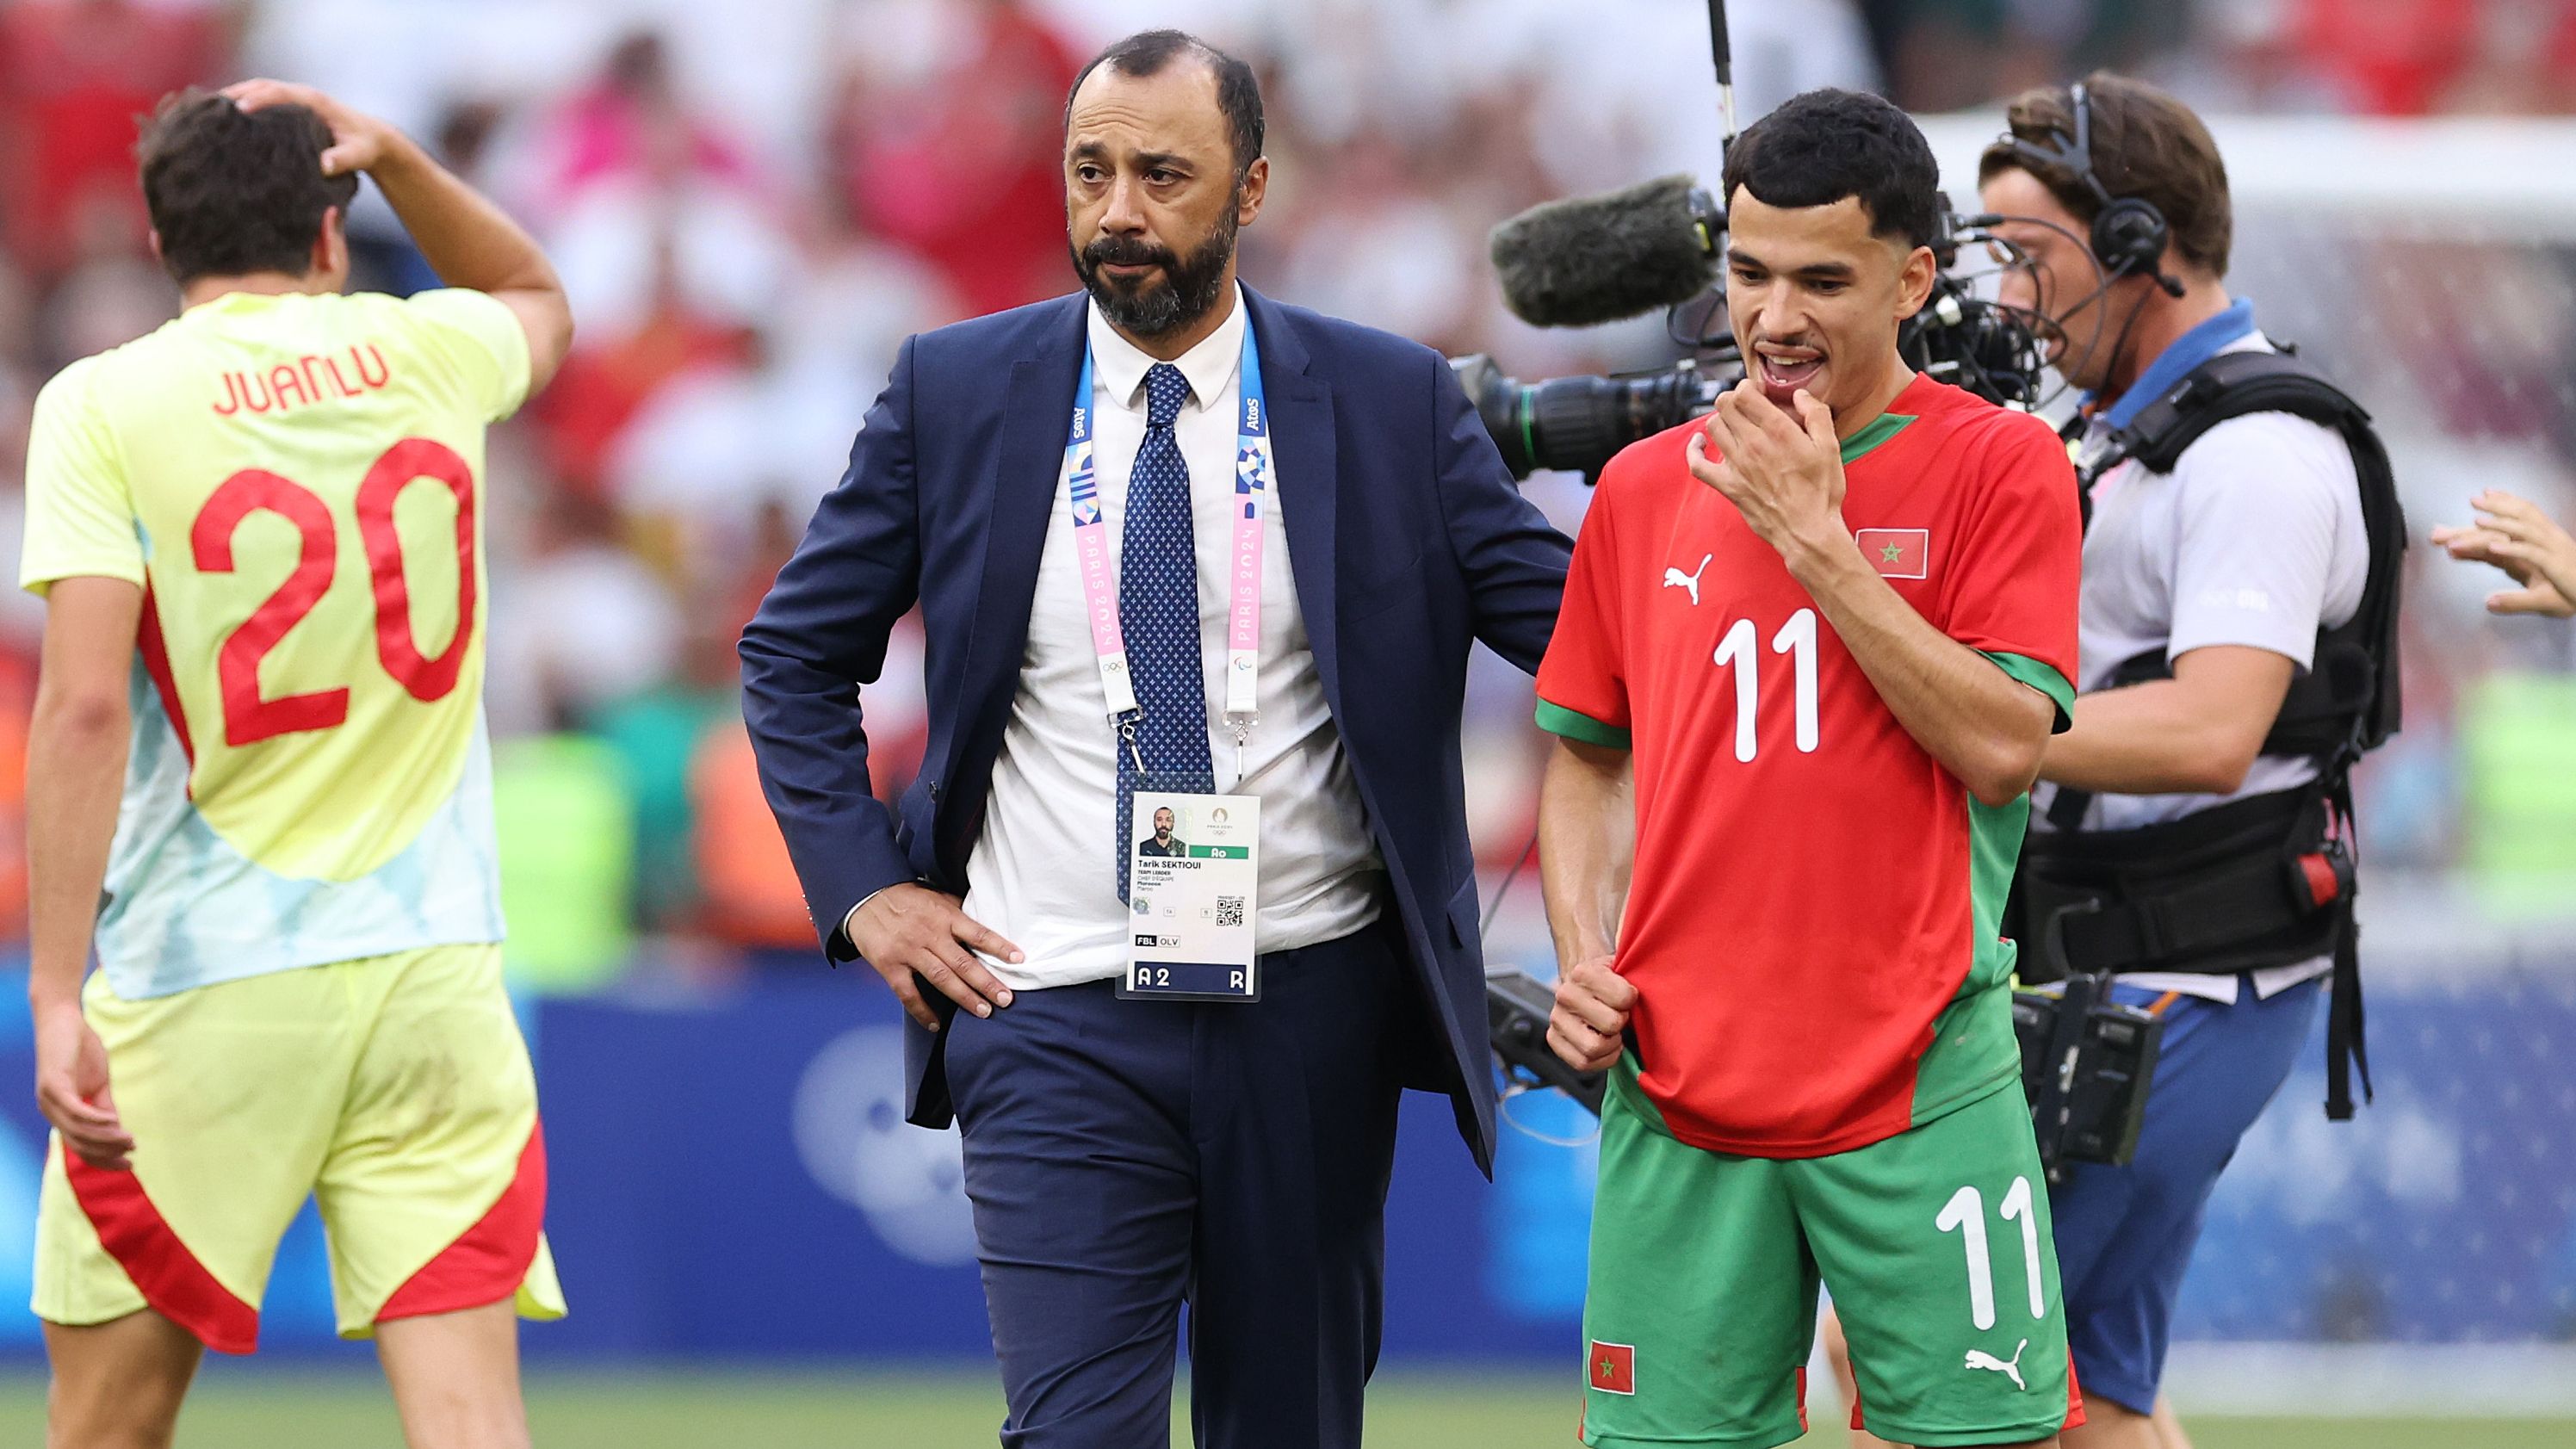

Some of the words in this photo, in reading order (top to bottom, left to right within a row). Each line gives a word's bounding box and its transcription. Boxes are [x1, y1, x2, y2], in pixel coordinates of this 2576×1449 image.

[213, 344, 389, 415] JUANLU
[1073, 407, 1086, 438] Atos
[1246, 399, 1259, 430] Atos
[1240, 529, 1254, 579] 2024
[190, 437, 477, 747] 20
[1085, 536, 1105, 590] PARIS
[1095, 595, 1113, 646] 2024
[1238, 586, 1252, 641] PARIS
[1713, 608, 1819, 763] 11
[1161, 861, 1201, 870] SEKTIOUI
[1137, 937, 1155, 945] FBL
[1137, 967, 1151, 986] A
[1156, 968, 1170, 986] 2
[1229, 970, 1244, 988] R
[1935, 1175, 2045, 1330] 11
